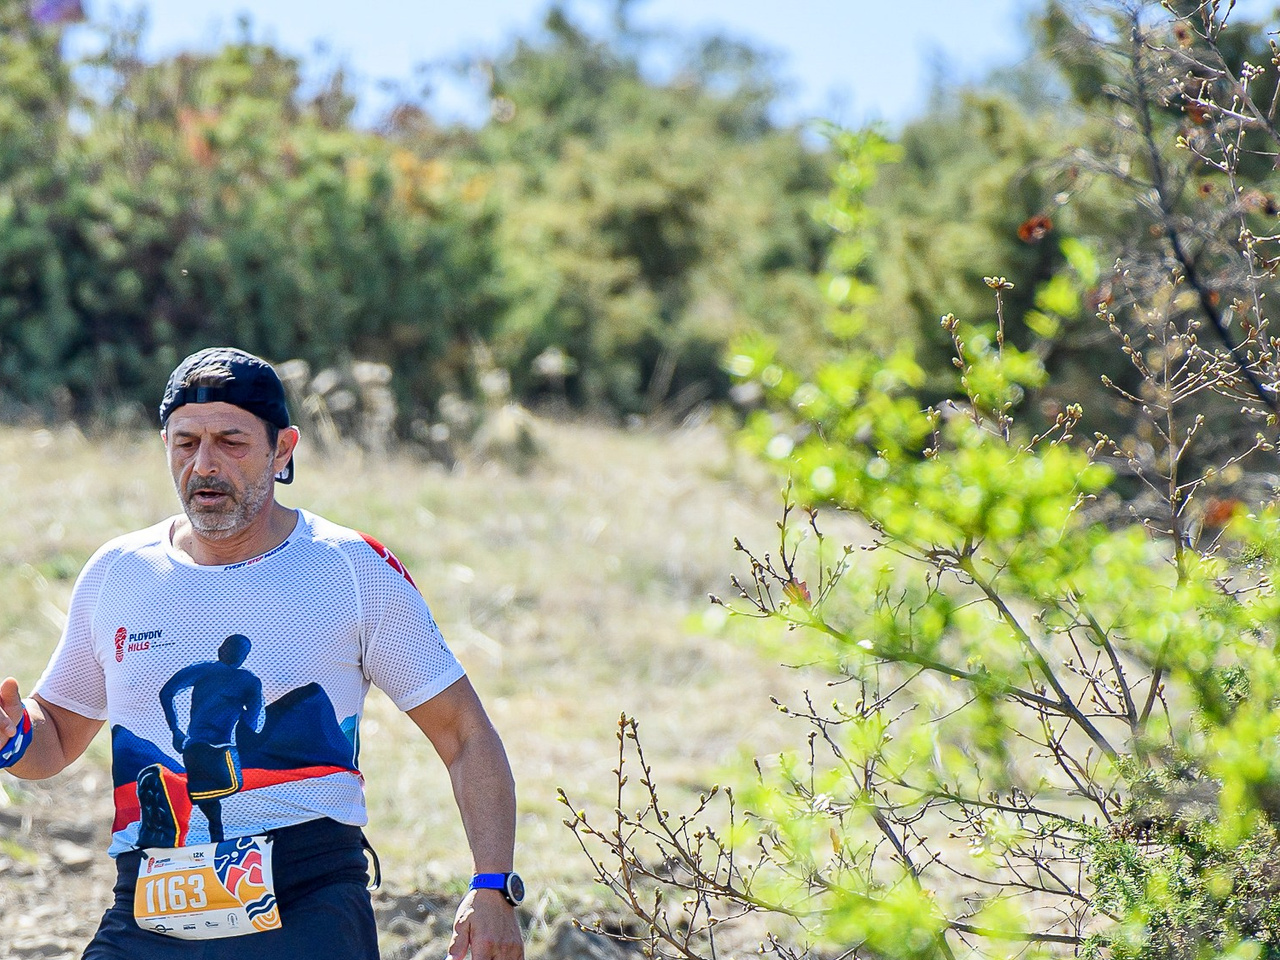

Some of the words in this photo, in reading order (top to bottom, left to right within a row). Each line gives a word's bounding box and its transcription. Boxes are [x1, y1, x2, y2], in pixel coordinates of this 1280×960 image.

[129, 630, 163, 642] PLOVDIV
[128, 641, 150, 652] HILLS
[145, 873, 208, 914] 1163
